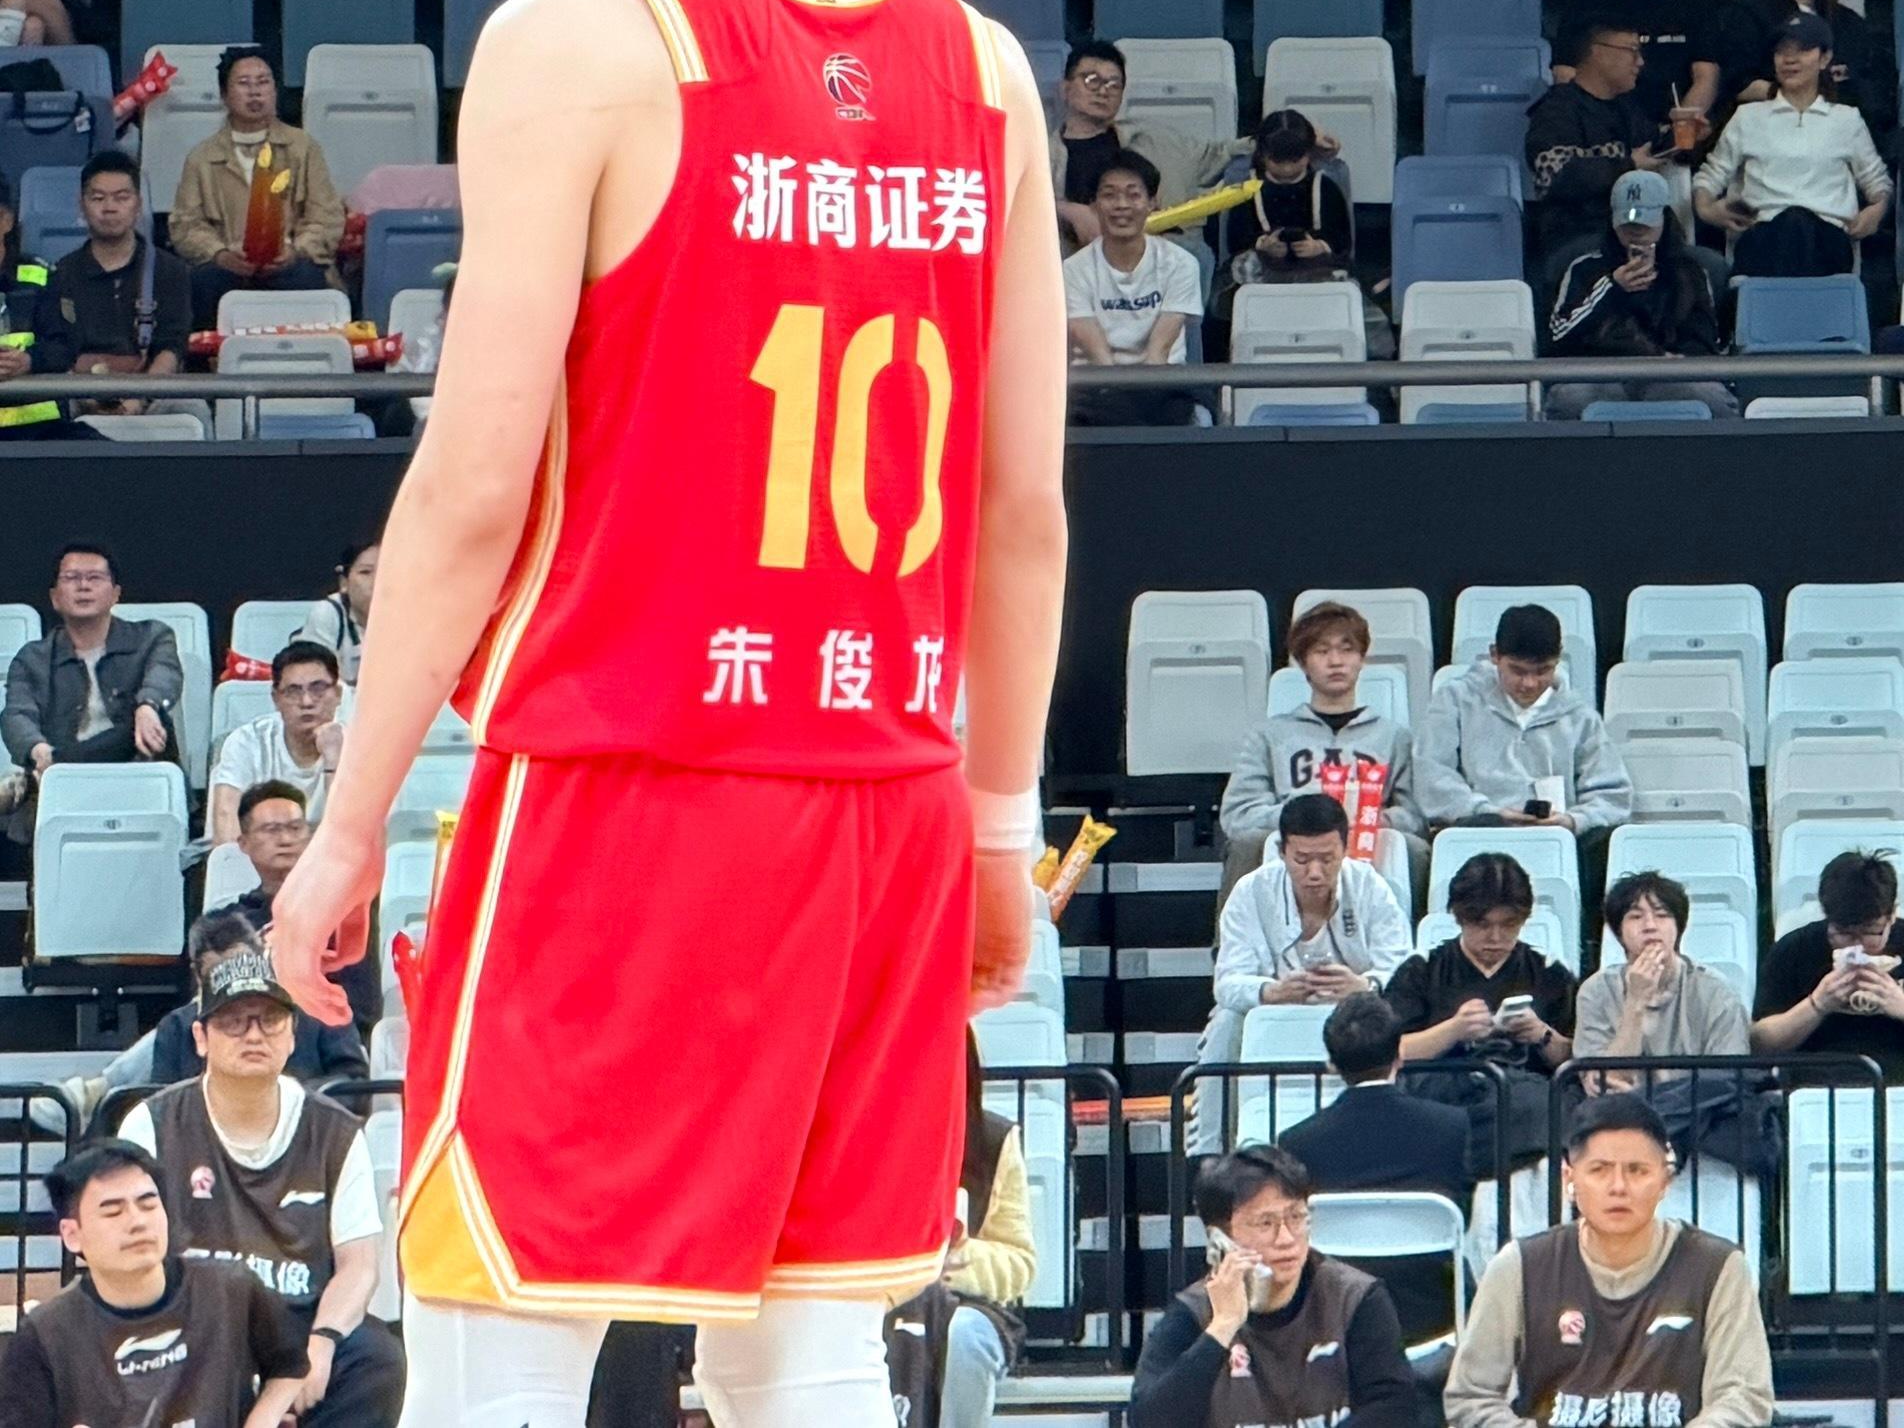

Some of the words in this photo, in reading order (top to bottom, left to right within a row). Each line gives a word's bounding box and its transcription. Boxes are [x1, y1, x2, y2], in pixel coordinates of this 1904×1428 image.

[732, 152, 988, 256] 浙商证券
[750, 302, 953, 579] 10
